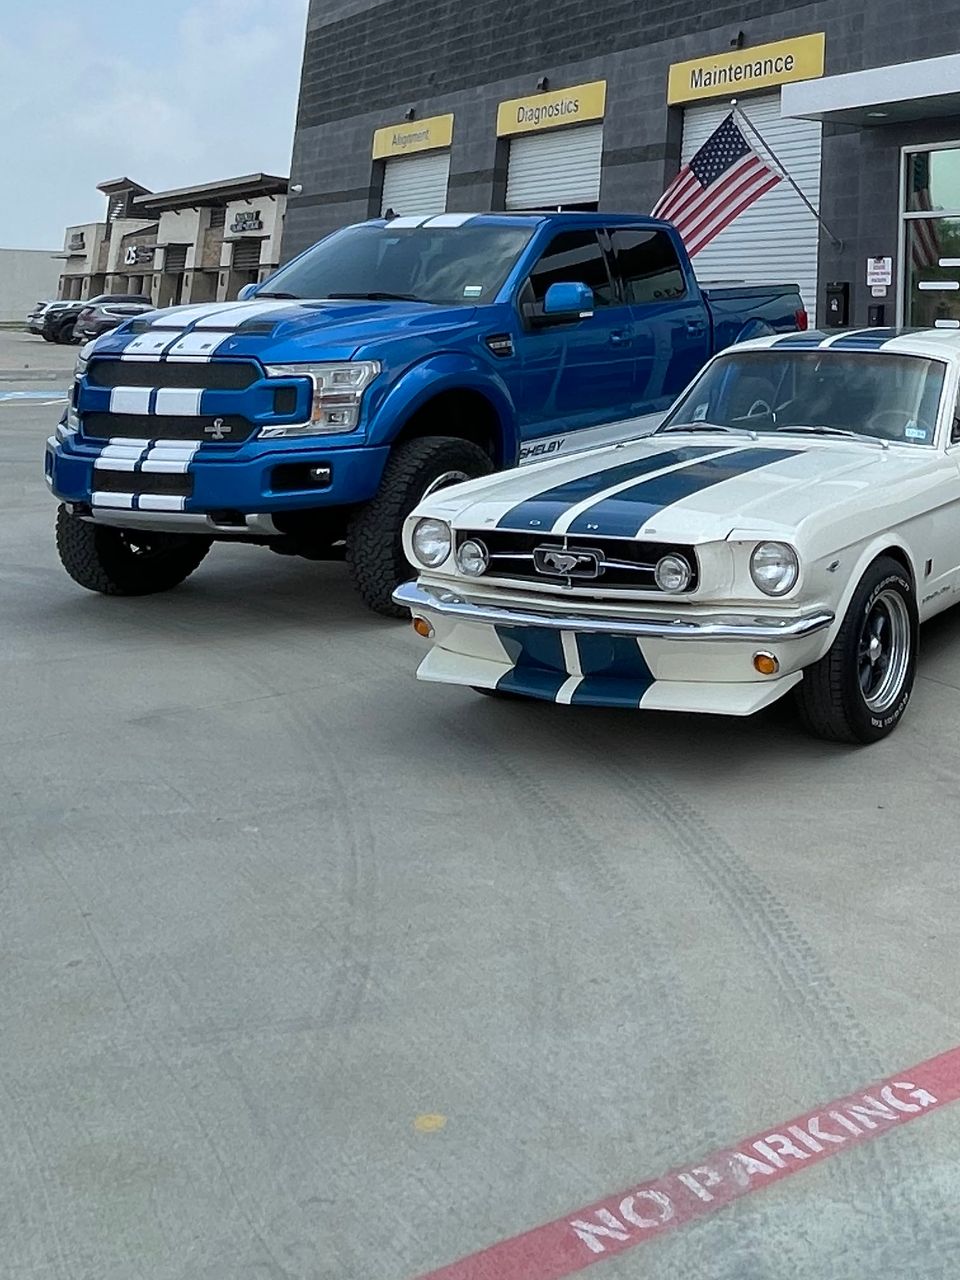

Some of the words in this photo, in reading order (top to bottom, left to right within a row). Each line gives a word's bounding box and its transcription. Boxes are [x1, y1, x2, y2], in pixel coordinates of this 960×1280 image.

[690, 54, 794, 89] Maintenance
[517, 99, 579, 124] Diagnostics
[520, 439, 565, 460] SHELBY
[570, 1189, 676, 1254] NO
[678, 1081, 939, 1202] PARKING
